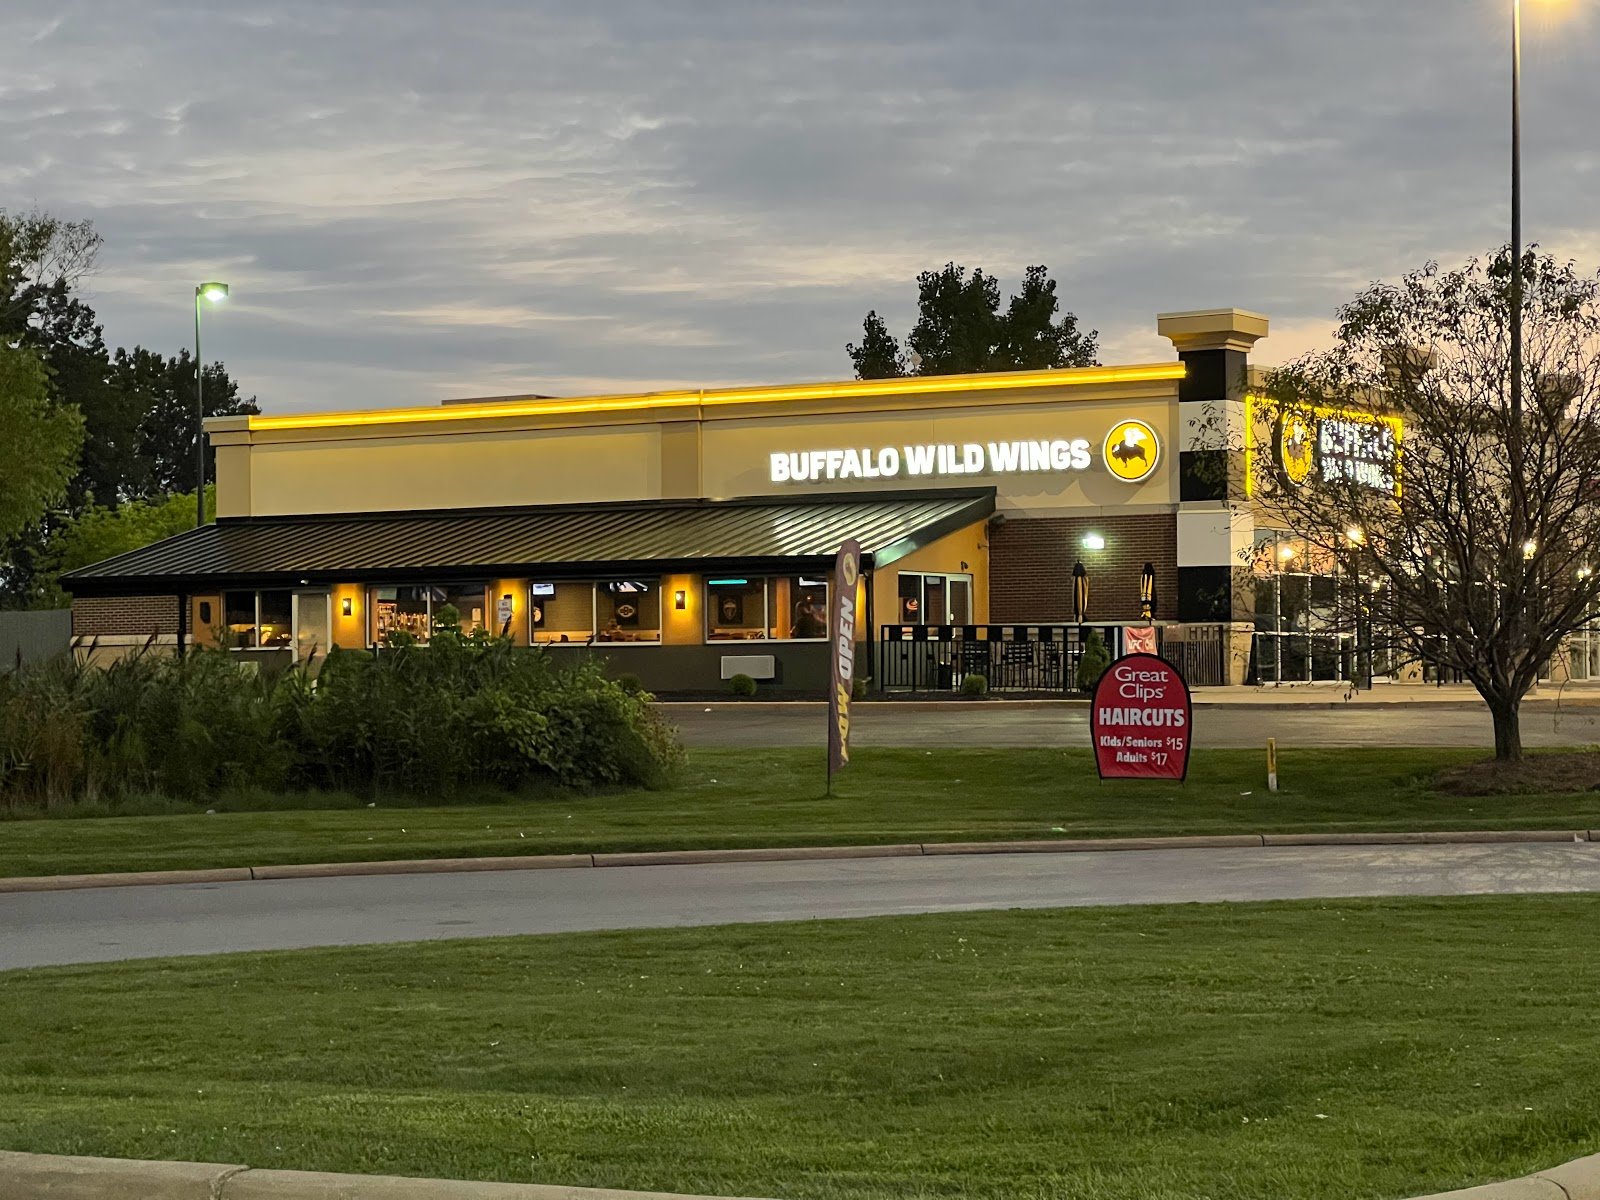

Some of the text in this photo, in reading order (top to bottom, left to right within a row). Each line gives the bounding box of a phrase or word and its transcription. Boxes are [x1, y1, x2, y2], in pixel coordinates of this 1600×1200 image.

[769, 438, 1091, 481] BUFFALO WILD WINGS
[838, 596, 854, 680] OPEN
[1114, 666, 1168, 683] Great
[1099, 707, 1185, 726] HAIRCUTS
[1100, 736, 1183, 751] Kids/Seniors $15
[1116, 751, 1168, 765] Adults $17
